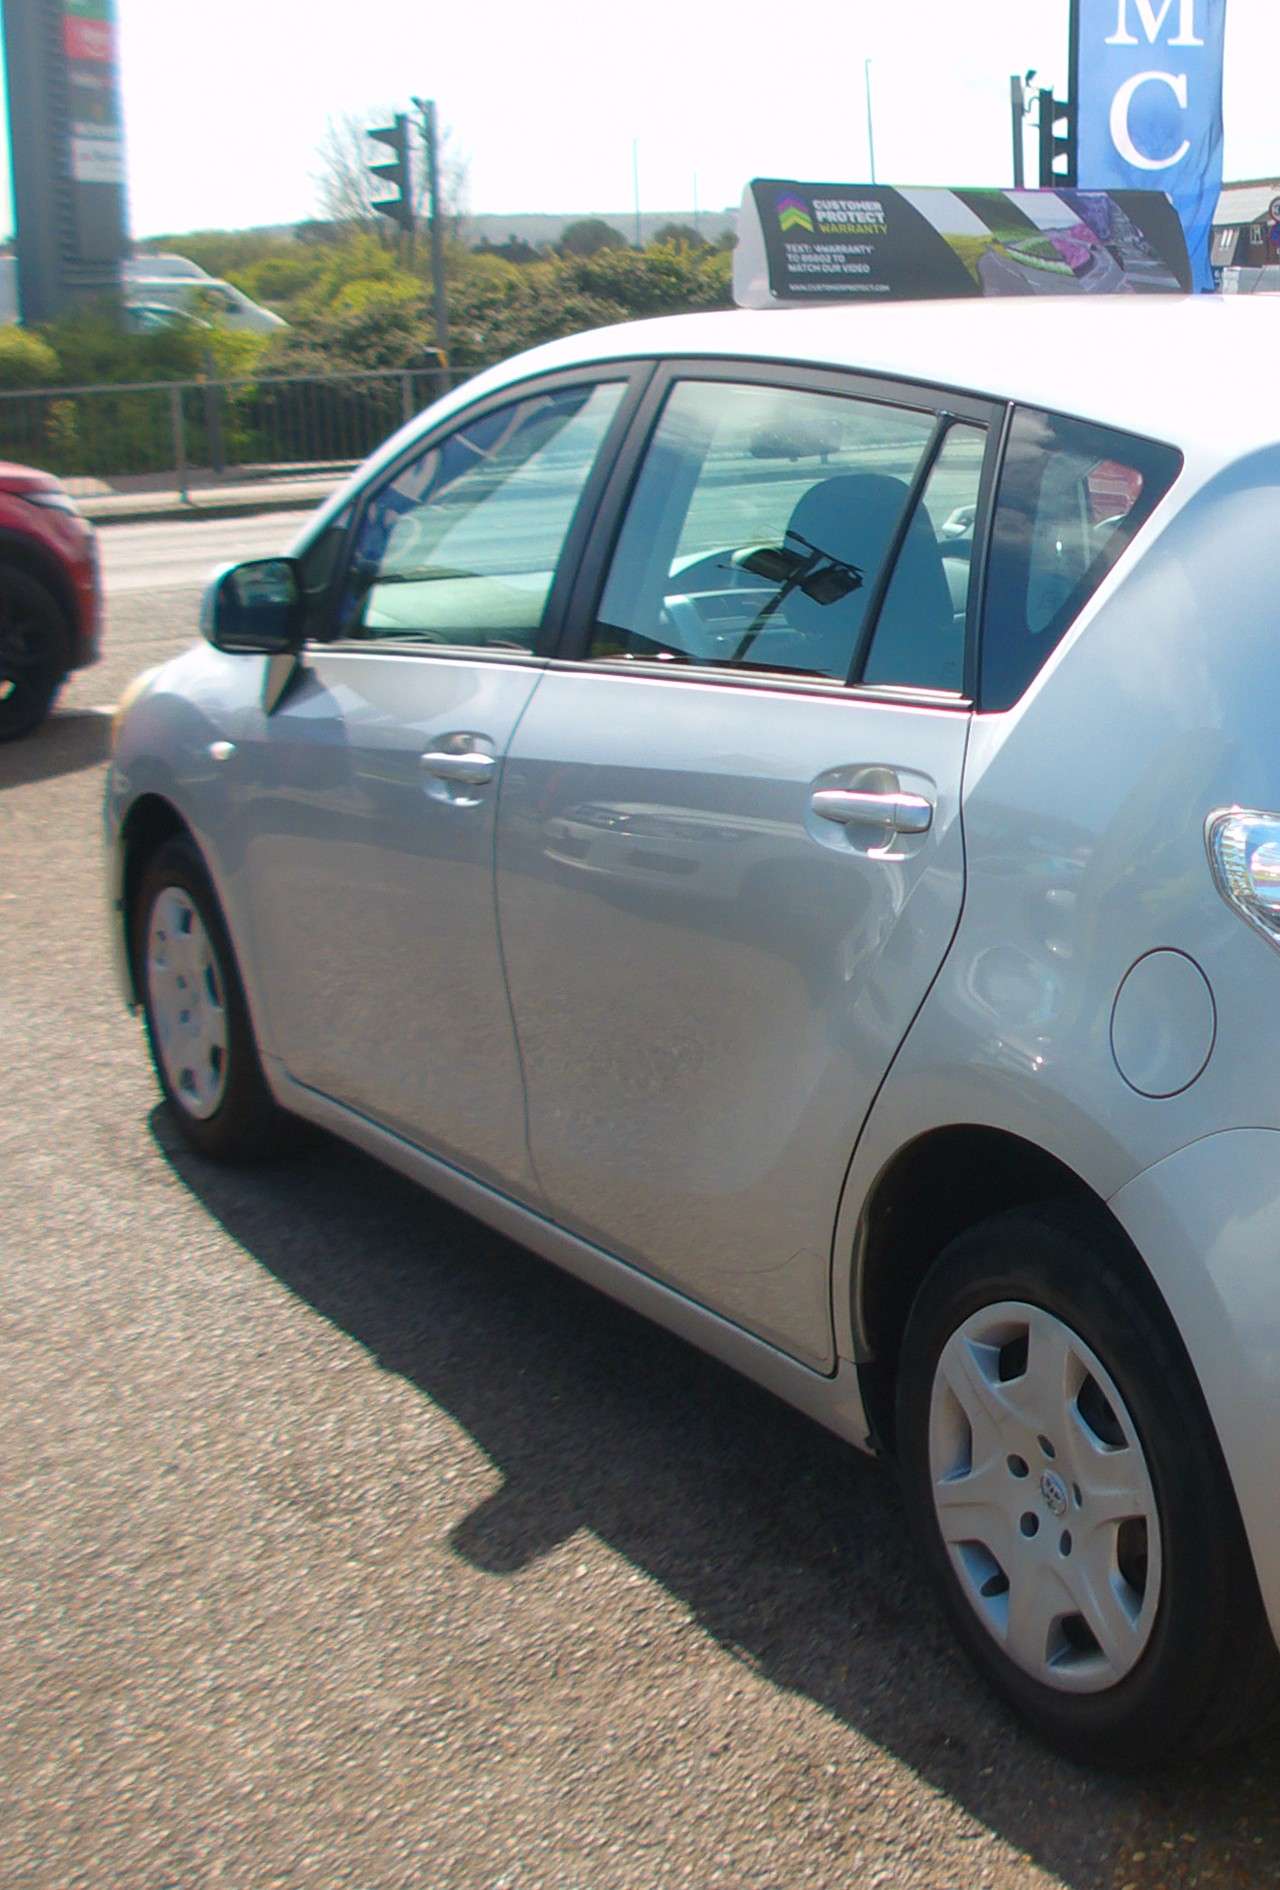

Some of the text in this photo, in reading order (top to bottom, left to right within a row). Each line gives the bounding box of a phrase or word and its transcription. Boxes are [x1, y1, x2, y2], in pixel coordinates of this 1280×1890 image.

[812, 199, 883, 211] CUSTOMER
[815, 211, 886, 224] PROTECT
[820, 223, 888, 235] WARRANTY
[841, 263, 871, 273] VIDEO
